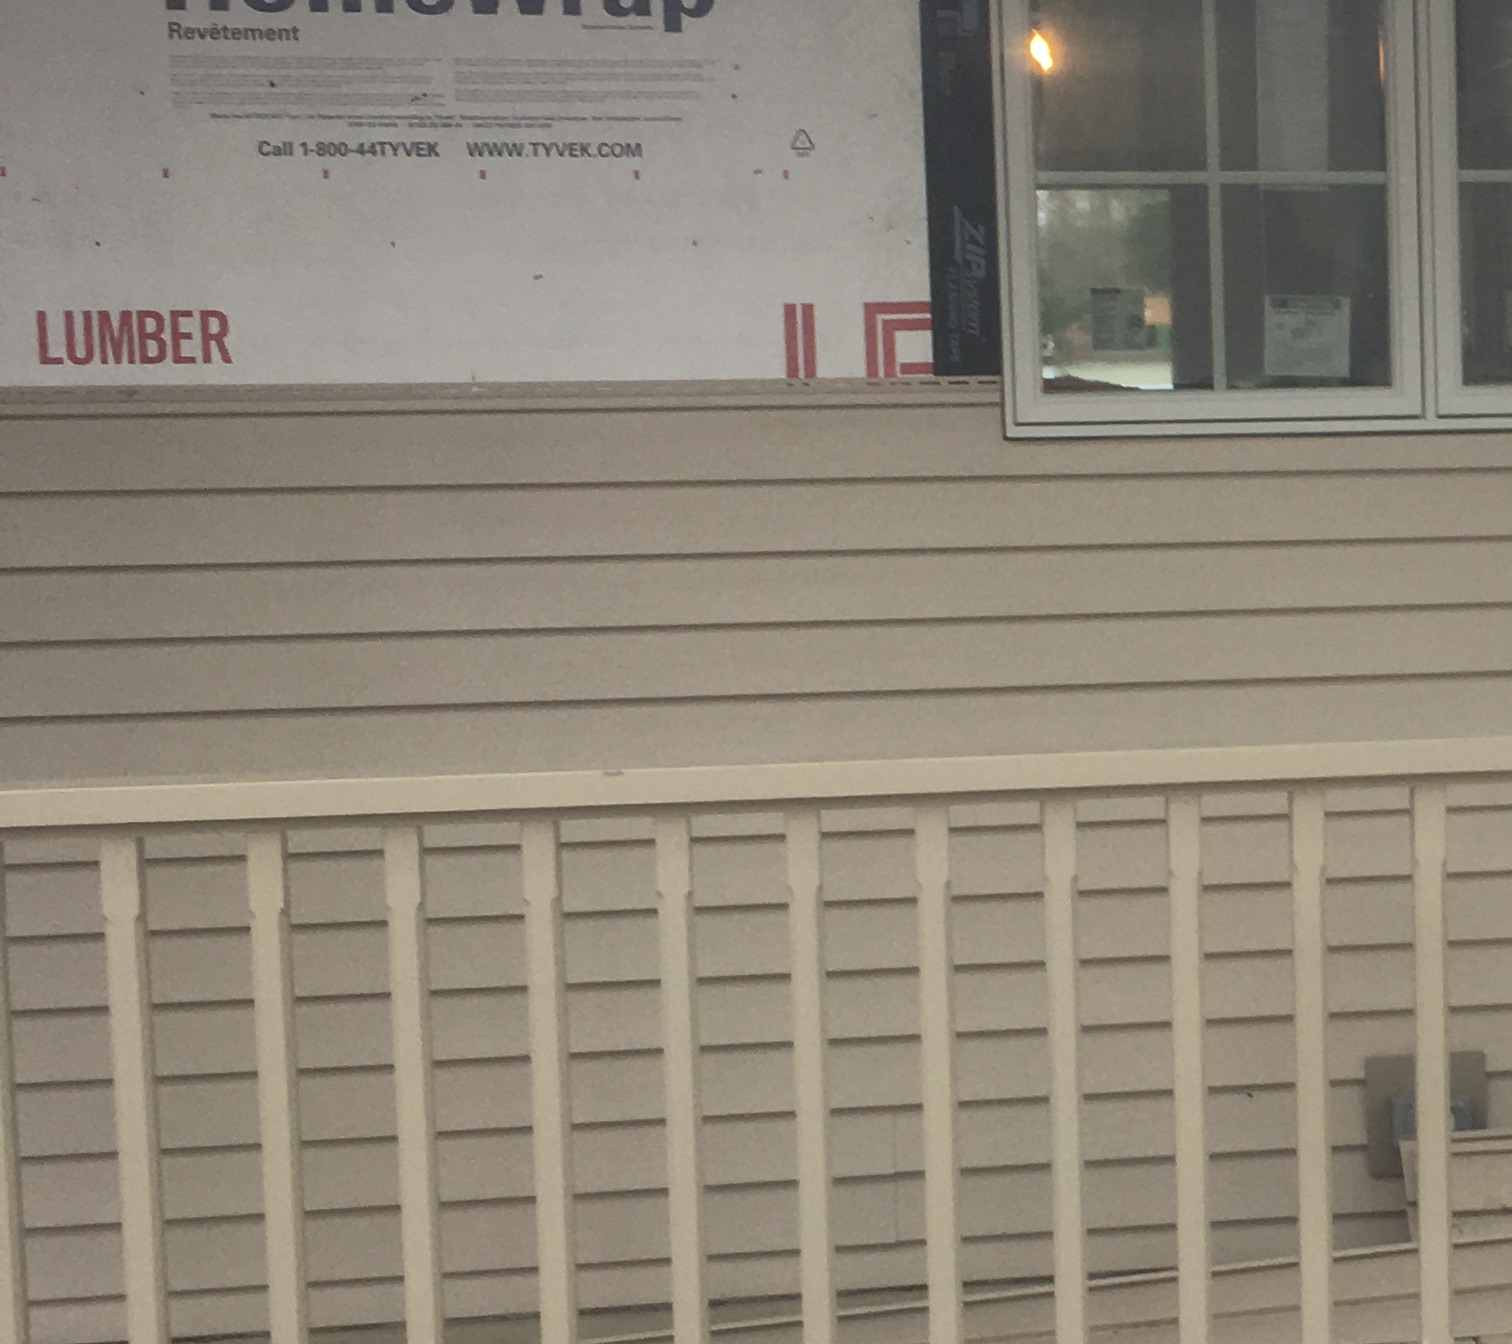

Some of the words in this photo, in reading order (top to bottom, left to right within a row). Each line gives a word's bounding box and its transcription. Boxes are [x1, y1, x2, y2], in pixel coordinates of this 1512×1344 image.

[167, 21, 301, 43] Revêtement
[258, 140, 295, 158] Call
[300, 141, 441, 159] 1-800-44TYVEK
[466, 142, 644, 159] WWW.TYVEK.COM
[36, 310, 233, 366] LUMBER
